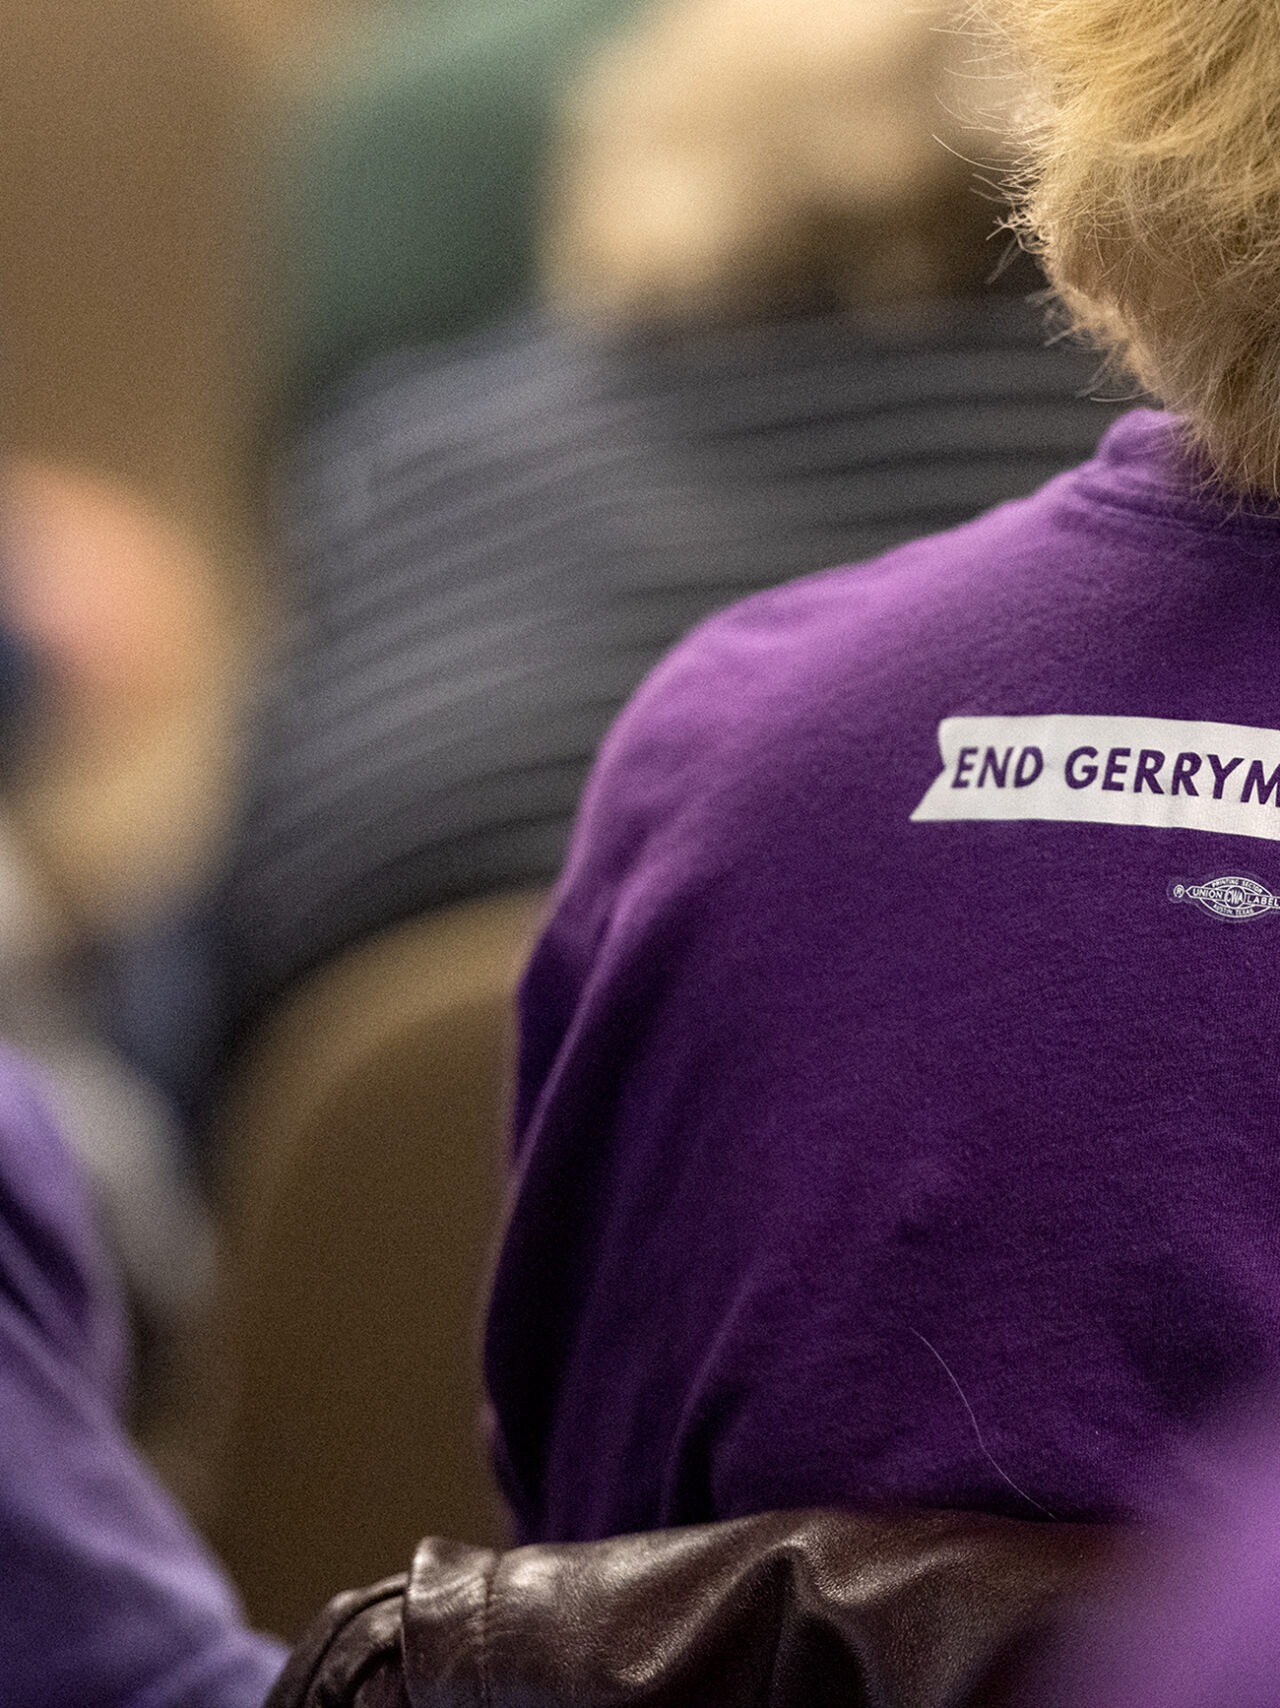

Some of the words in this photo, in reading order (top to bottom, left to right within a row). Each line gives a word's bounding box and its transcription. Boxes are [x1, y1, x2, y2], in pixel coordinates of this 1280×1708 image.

[951, 746, 1044, 788] END
[1192, 888, 1224, 899] UNION
[1226, 889, 1244, 905] CWA
[1247, 895, 1279, 907] LABEL
